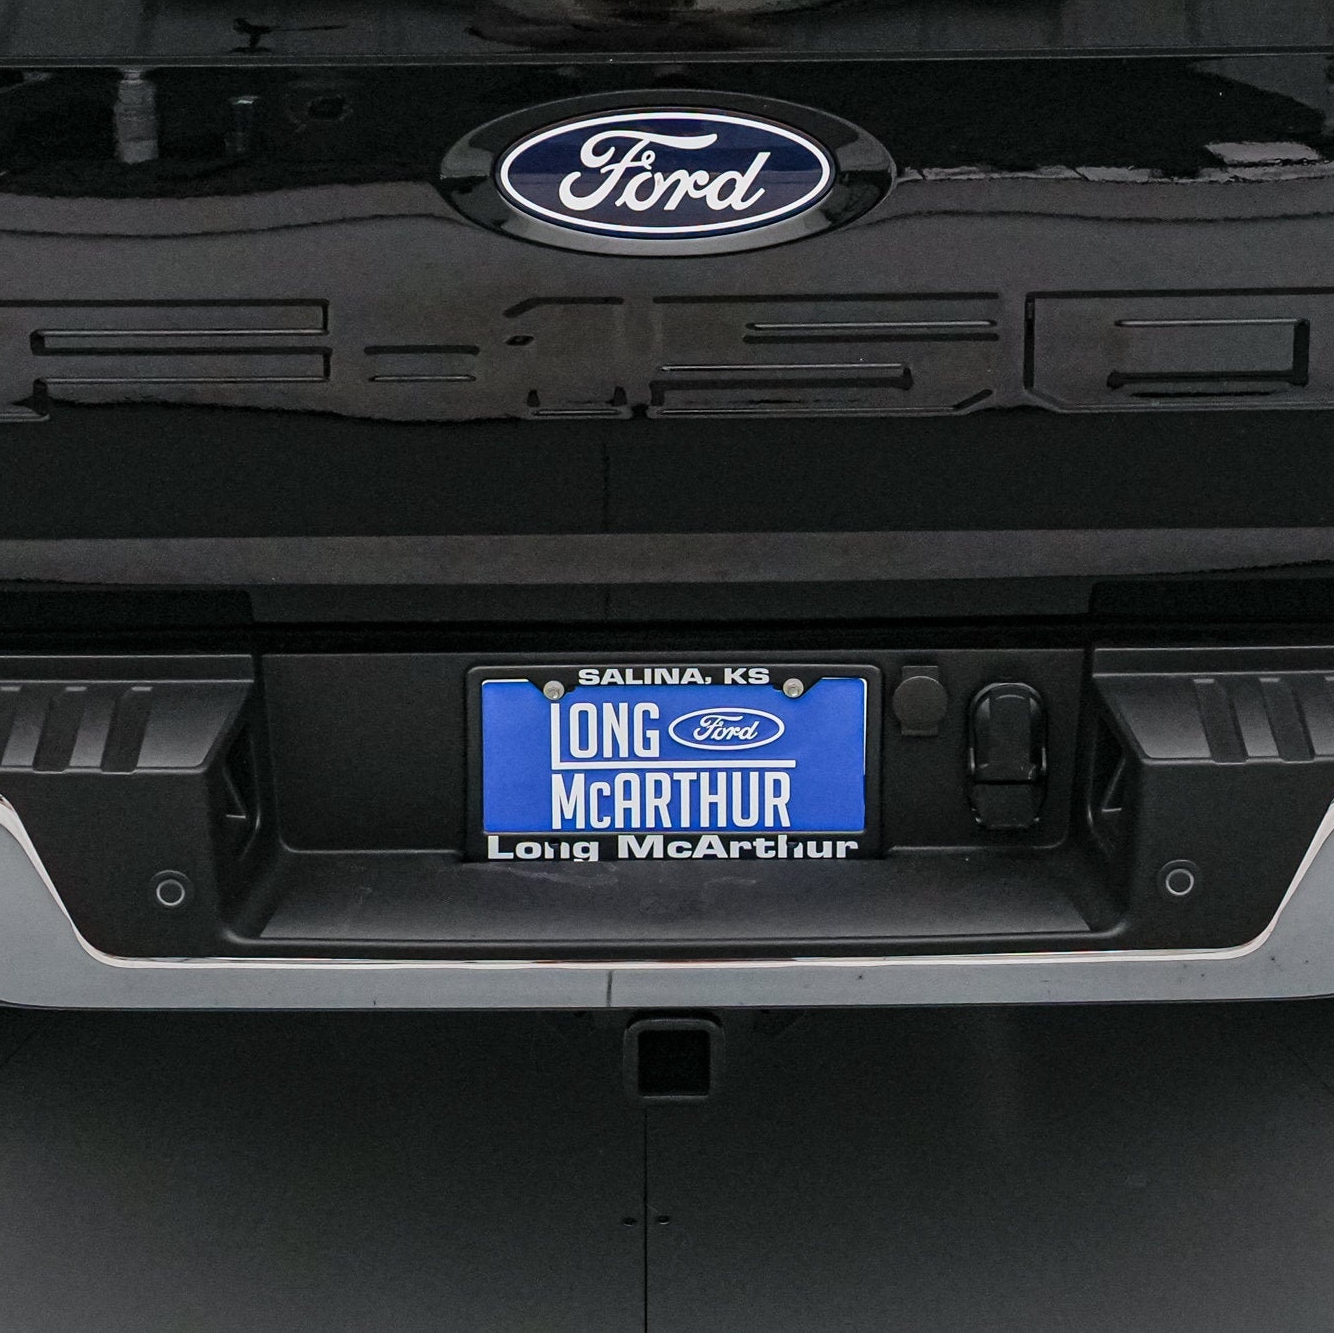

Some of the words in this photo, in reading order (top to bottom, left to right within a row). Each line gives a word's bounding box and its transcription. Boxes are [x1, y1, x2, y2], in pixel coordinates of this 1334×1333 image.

[558, 129, 771, 212] Ford
[578, 667, 712, 686] SALINA,
[723, 667, 771, 685] KS
[551, 702, 661, 769] LONG
[692, 714, 759, 742] Ford
[551, 771, 792, 830] McARTHUR
[486, 835, 600, 863] Long
[617, 834, 859, 860] McArthur
